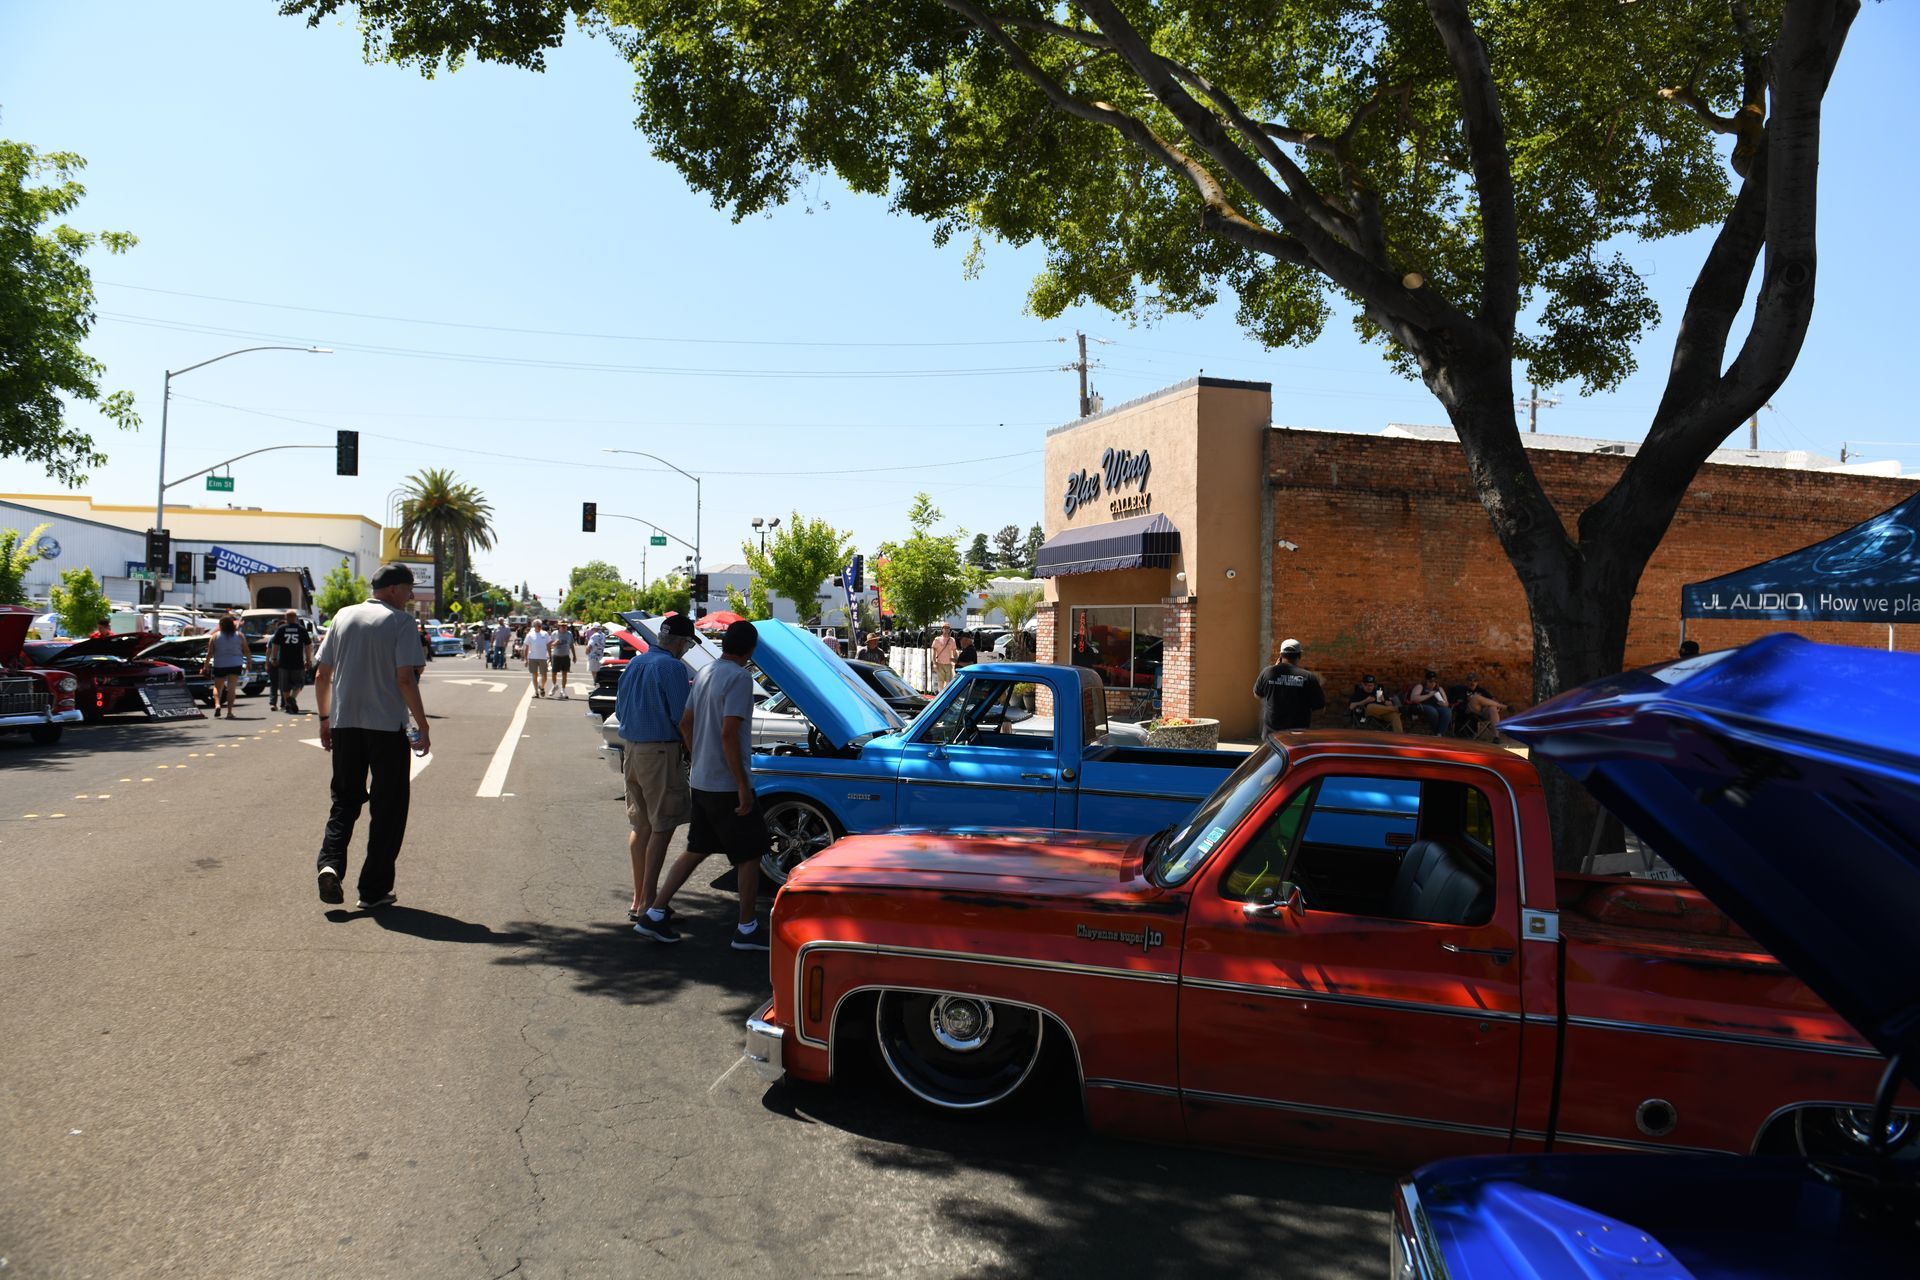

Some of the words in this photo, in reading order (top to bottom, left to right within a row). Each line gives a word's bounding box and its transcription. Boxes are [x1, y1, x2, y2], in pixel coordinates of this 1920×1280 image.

[1063, 468, 1100, 517] Blue
[1102, 447, 1151, 494] Wing
[1110, 492, 1151, 514] GALLERY
[220, 551, 269, 573] UNDER
[1703, 594, 1727, 610] JL
[1820, 593, 1858, 611] How
[1863, 598, 1889, 612] we
[284, 633, 299, 644] 75
[1149, 931, 1162, 946] 10
